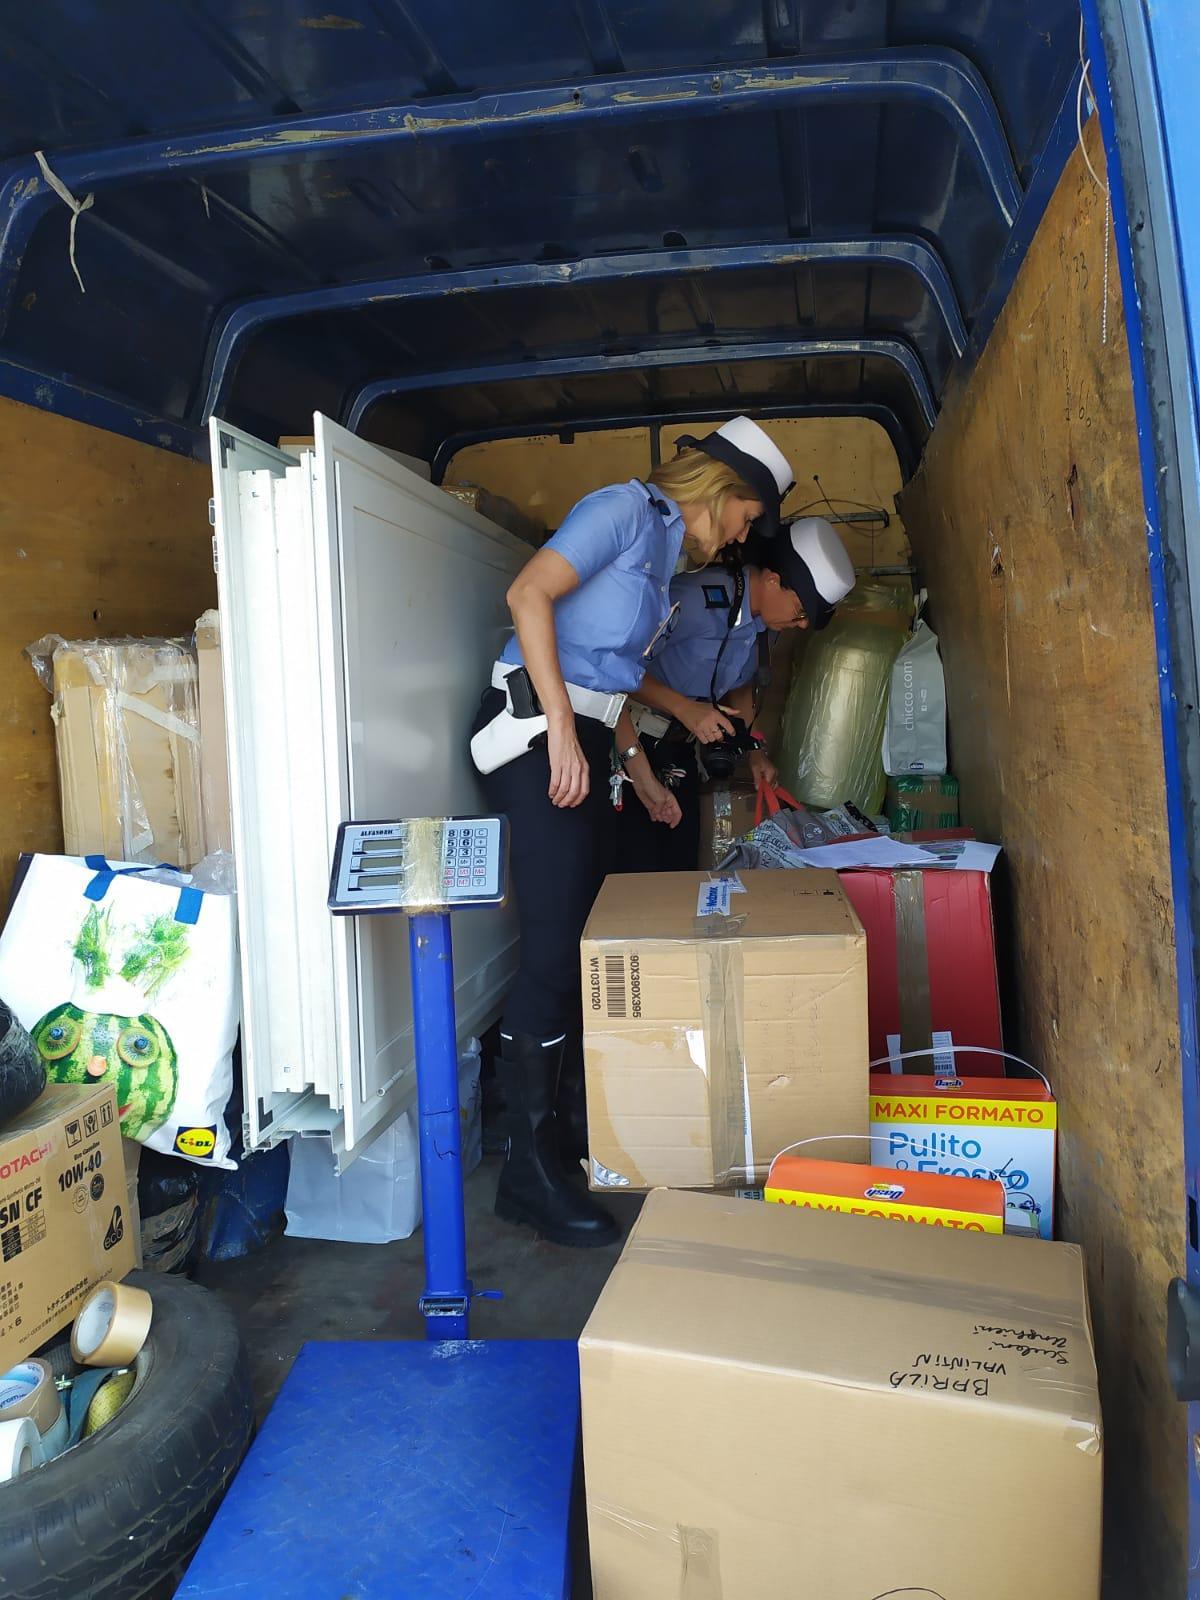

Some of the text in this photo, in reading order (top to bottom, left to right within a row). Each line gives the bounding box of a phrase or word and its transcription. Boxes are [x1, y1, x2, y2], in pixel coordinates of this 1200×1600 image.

[901, 660, 914, 731] chicco.com
[447, 829, 455, 837] 8
[463, 829, 470, 837] 9
[447, 839, 470, 847] 5 6
[446, 849, 454, 857] 2
[461, 848, 469, 856] 3
[589, 957, 601, 1010] W103T020
[935, 1079, 962, 1087] Dash
[875, 1102, 1044, 1124] MAXI FORMATO
[889, 1132, 982, 1159] Pulito
[58, 1150, 102, 1192] 10W-40
[25, 1186, 43, 1212] CF
[867, 1188, 904, 1199] Dash
[104, 1228, 123, 1248] eco
